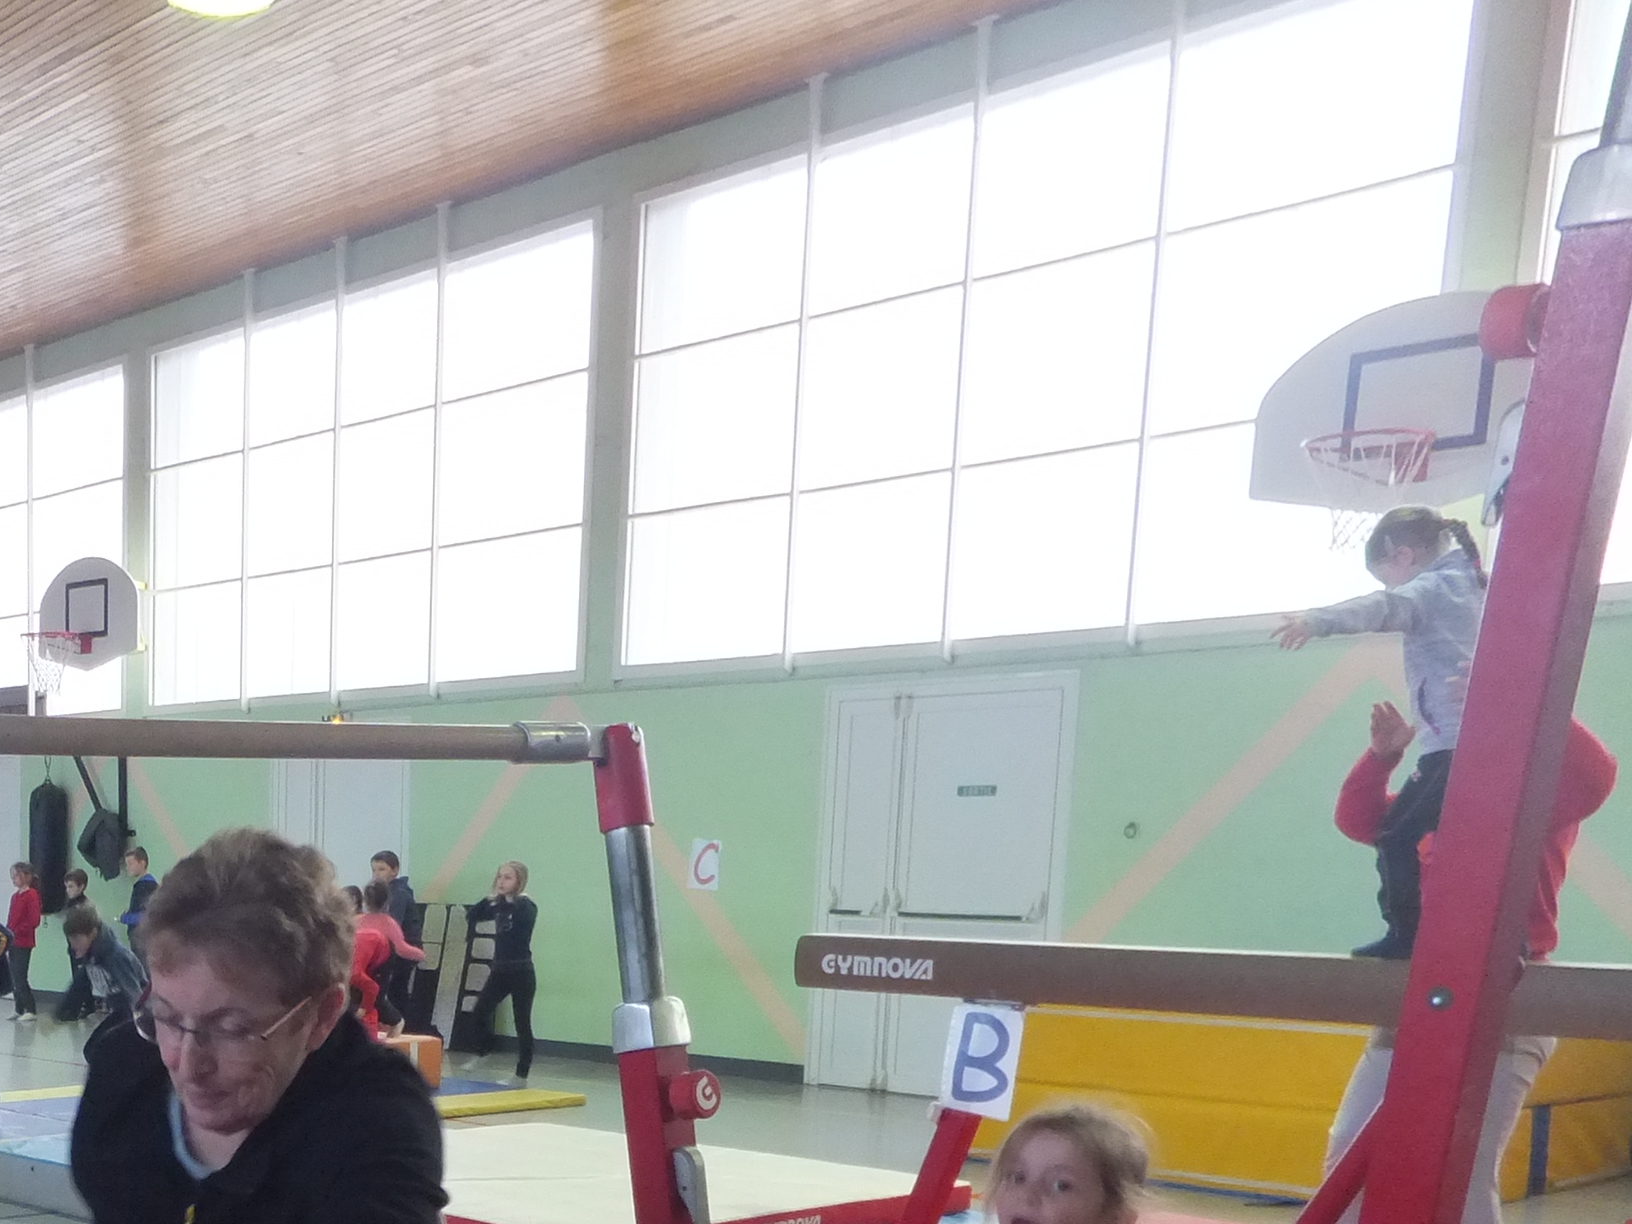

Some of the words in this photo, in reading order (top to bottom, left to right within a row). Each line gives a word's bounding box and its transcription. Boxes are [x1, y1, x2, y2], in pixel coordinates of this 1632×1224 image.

[693, 842, 719, 885] C
[821, 953, 934, 980] GYMNOVA
[951, 1011, 1011, 1103] B
